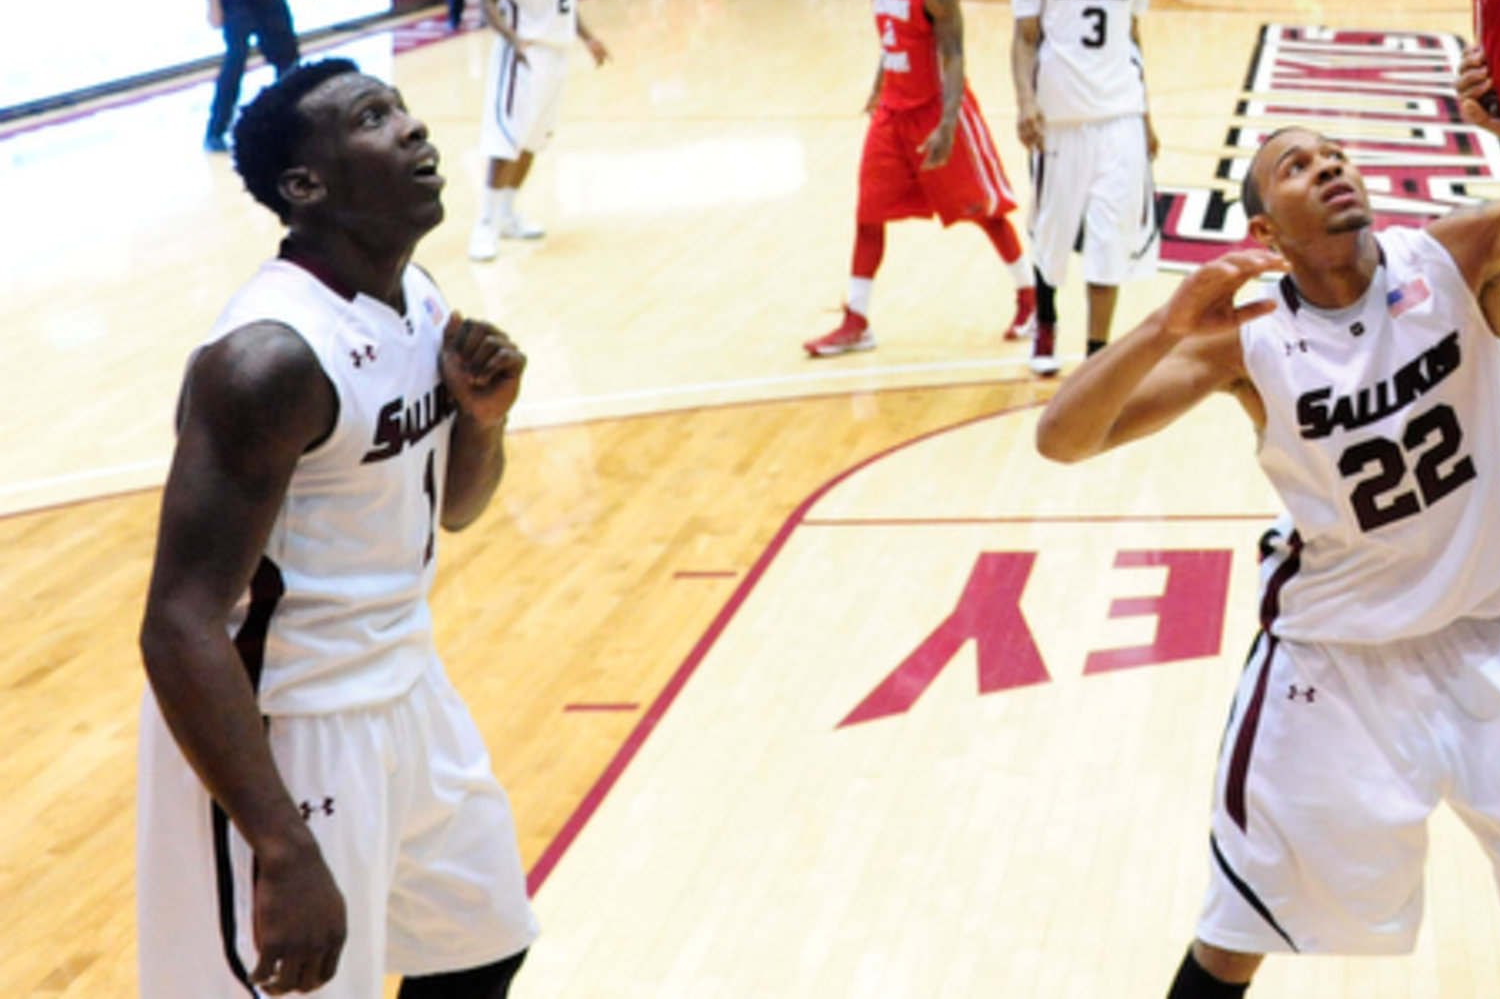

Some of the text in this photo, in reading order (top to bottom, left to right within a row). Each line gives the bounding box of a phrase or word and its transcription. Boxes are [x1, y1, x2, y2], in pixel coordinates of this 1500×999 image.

[1081, 7, 1107, 49] 3
[1296, 328, 1462, 441] SALUKIS
[1337, 403, 1478, 533] 22
